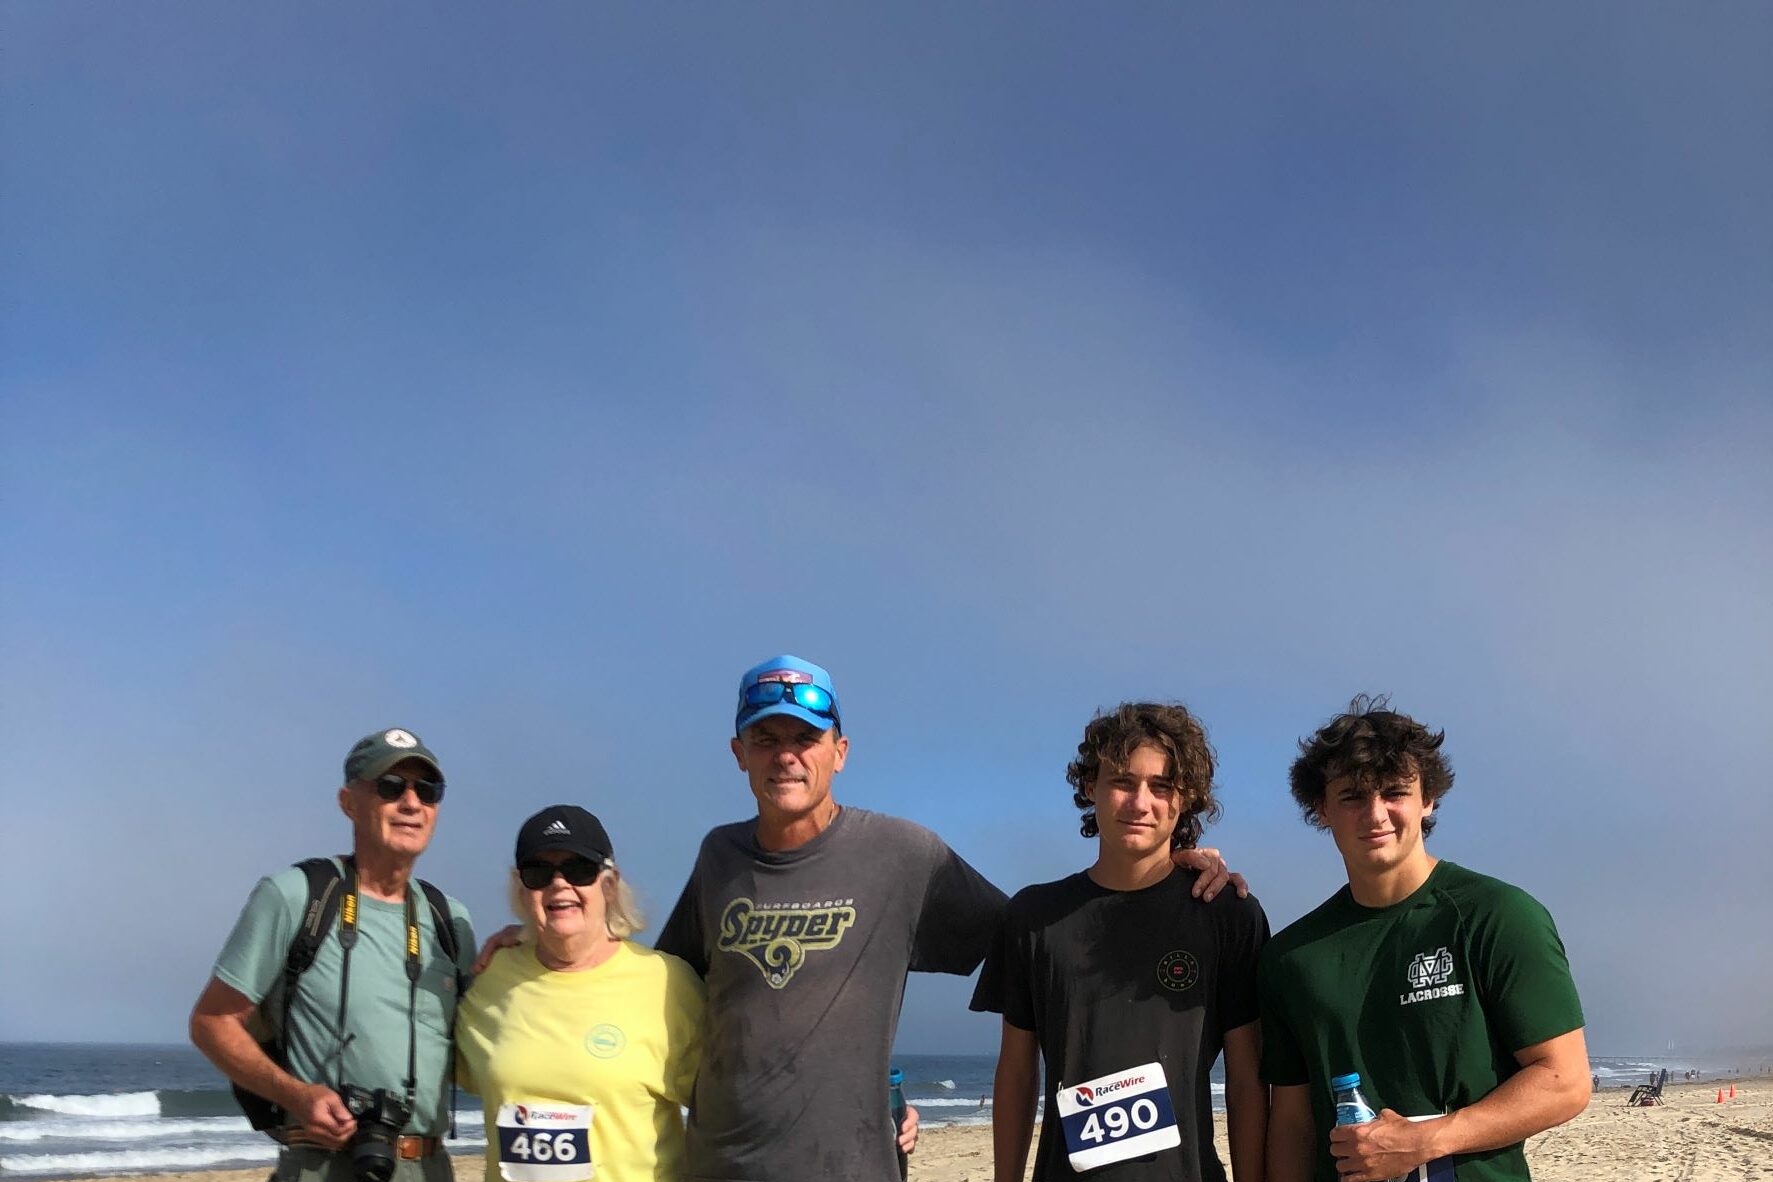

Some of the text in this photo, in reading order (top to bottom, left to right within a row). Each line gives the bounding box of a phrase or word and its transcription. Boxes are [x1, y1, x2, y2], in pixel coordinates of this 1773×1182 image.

[343, 894, 357, 924] Nikon
[408, 925, 419, 955] Nikon
[1400, 984, 1464, 1006] LACROSSE
[1095, 1076, 1145, 1097] RaceWire
[1080, 1098, 1158, 1143] 490
[510, 1132, 577, 1162] 466
